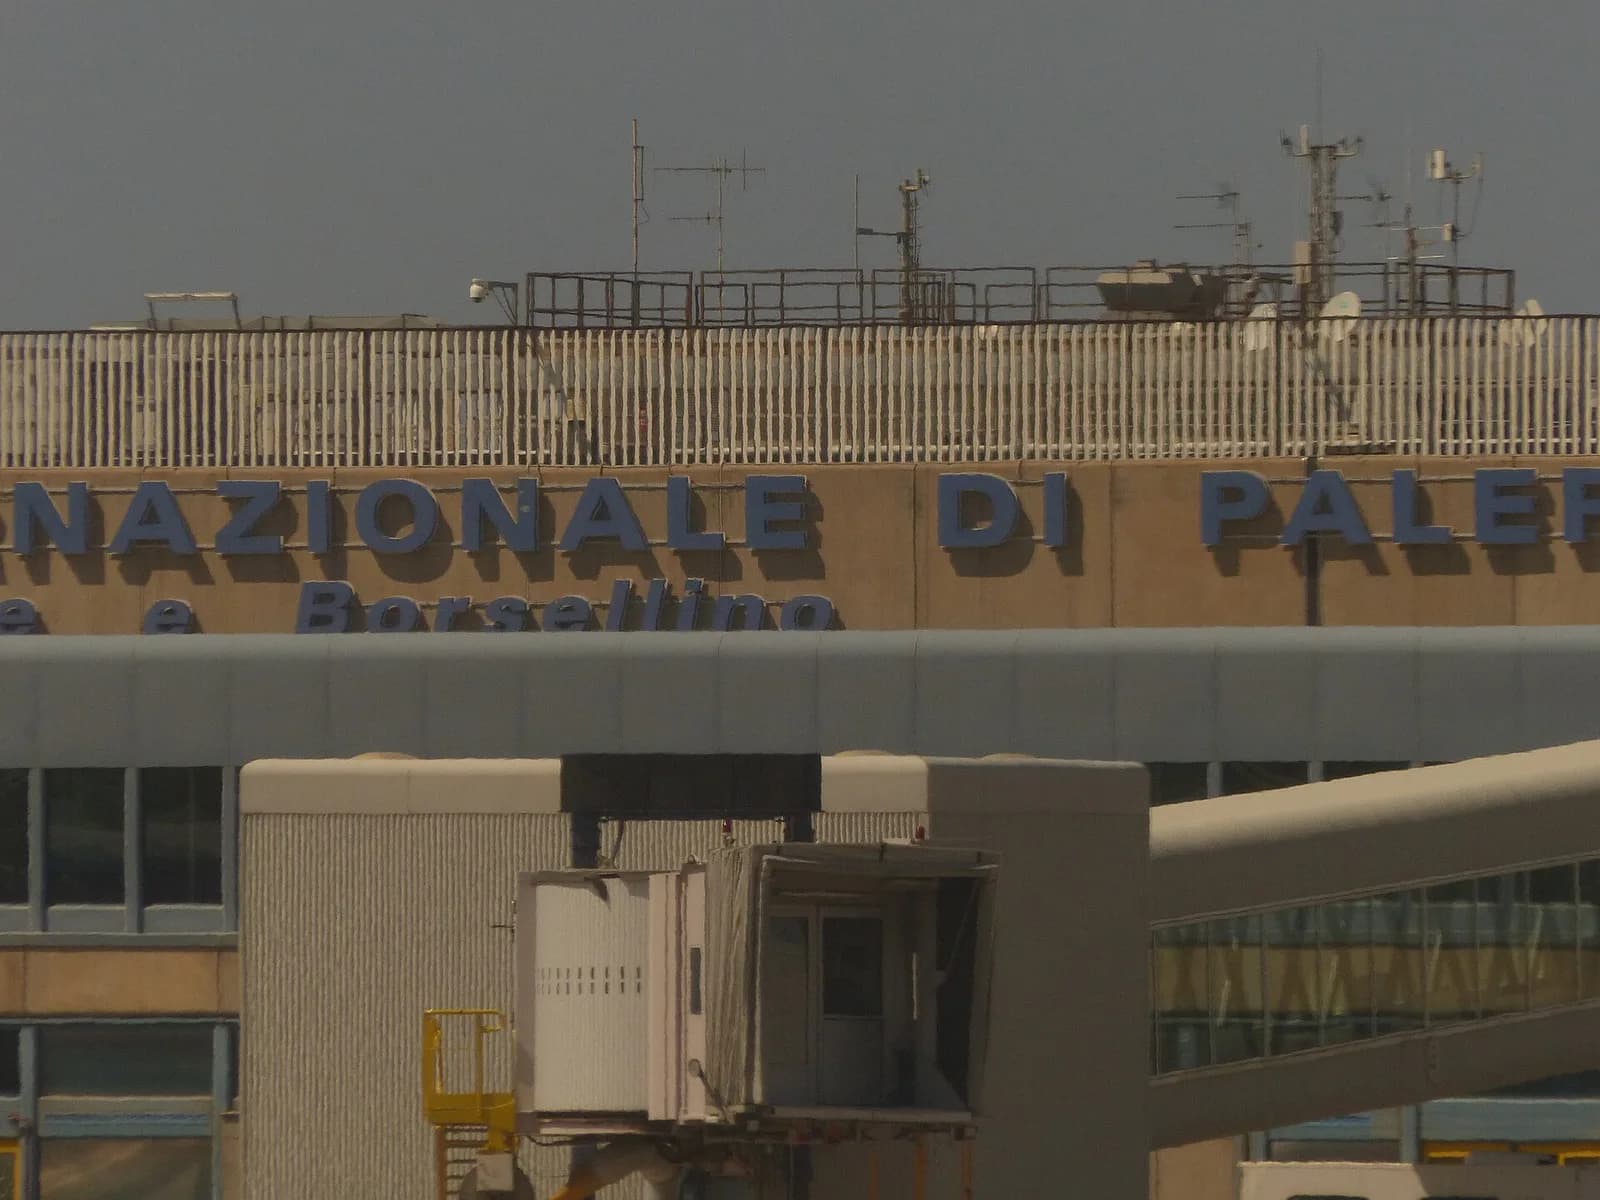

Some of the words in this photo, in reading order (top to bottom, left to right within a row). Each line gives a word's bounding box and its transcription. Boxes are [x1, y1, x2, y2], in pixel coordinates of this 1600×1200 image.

[13, 474, 808, 554] NAZIONALE
[938, 471, 1067, 547] DI
[143, 598, 193, 634] e
[295, 577, 834, 634] Borsellino
